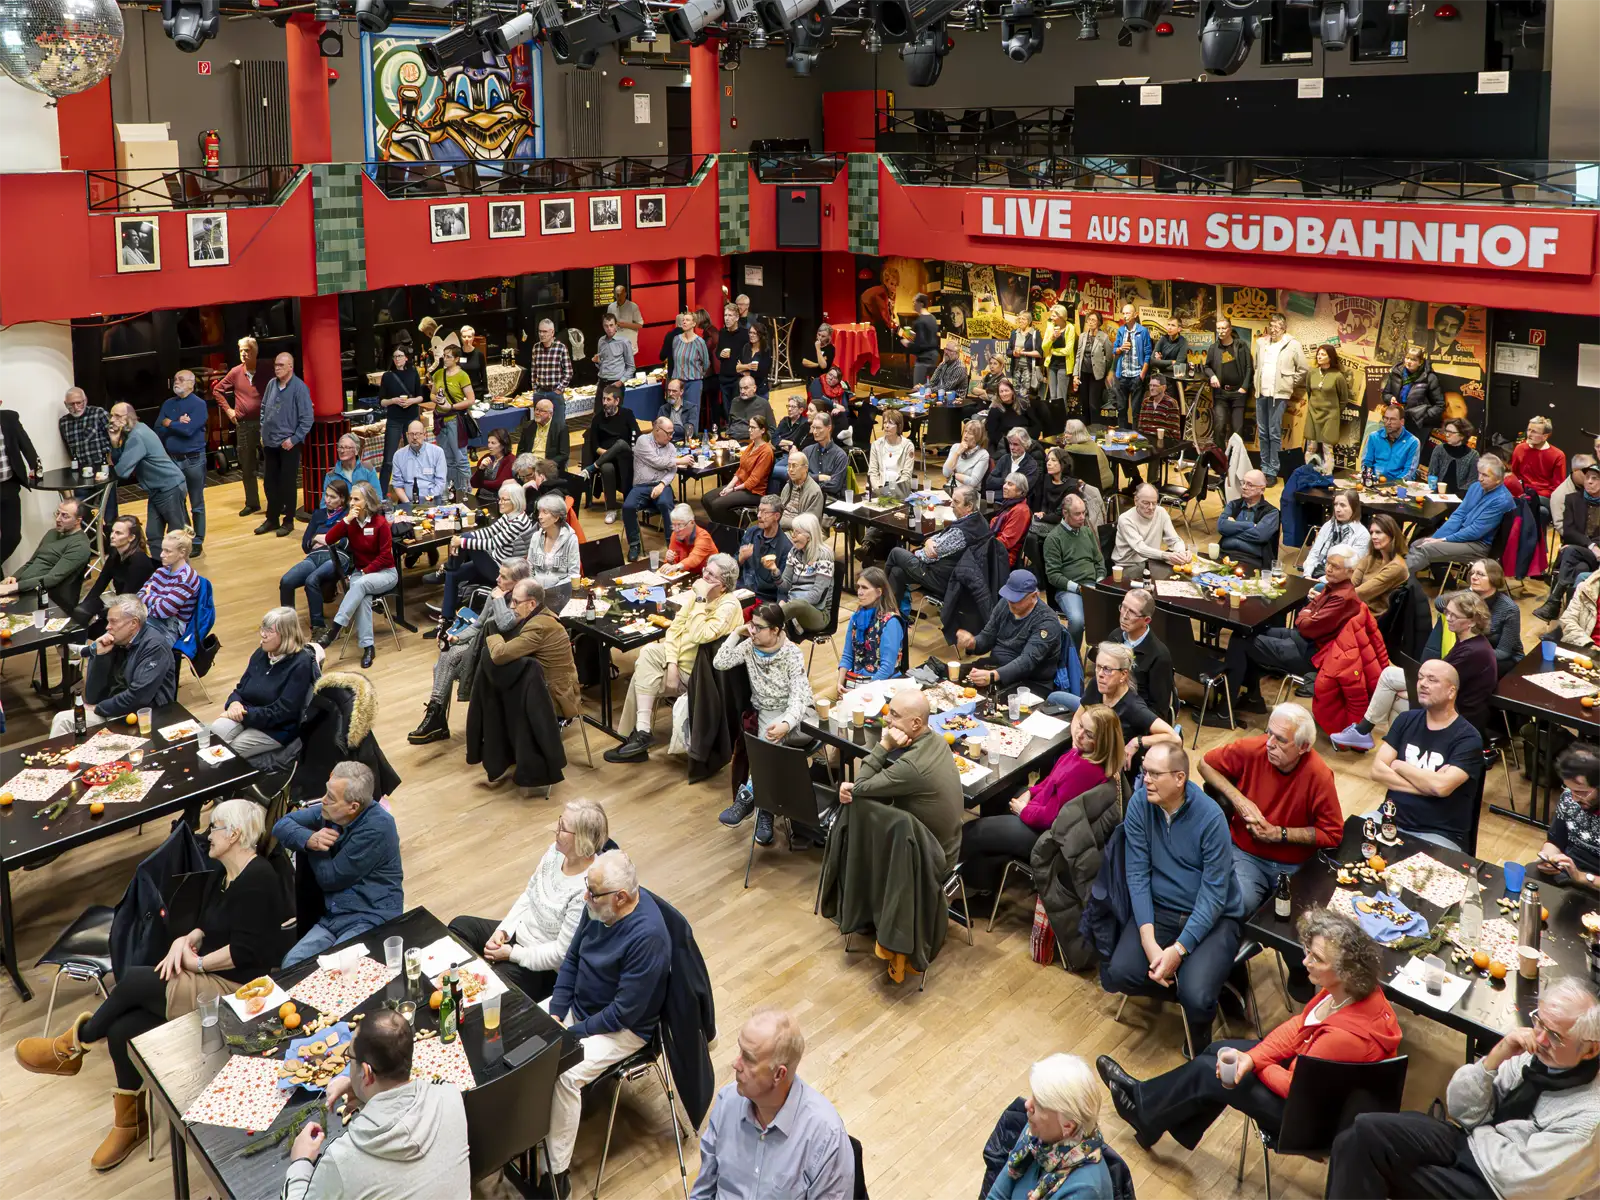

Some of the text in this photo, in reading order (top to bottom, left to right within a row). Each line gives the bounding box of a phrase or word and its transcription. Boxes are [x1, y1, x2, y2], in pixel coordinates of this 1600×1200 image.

[981, 196, 1072, 240] LIVE
[1087, 215, 1131, 244] AUS
[1138, 217, 1189, 247] DEM
[1084, 281, 1114, 299] Acker
[1087, 297, 1111, 312] Bilk
